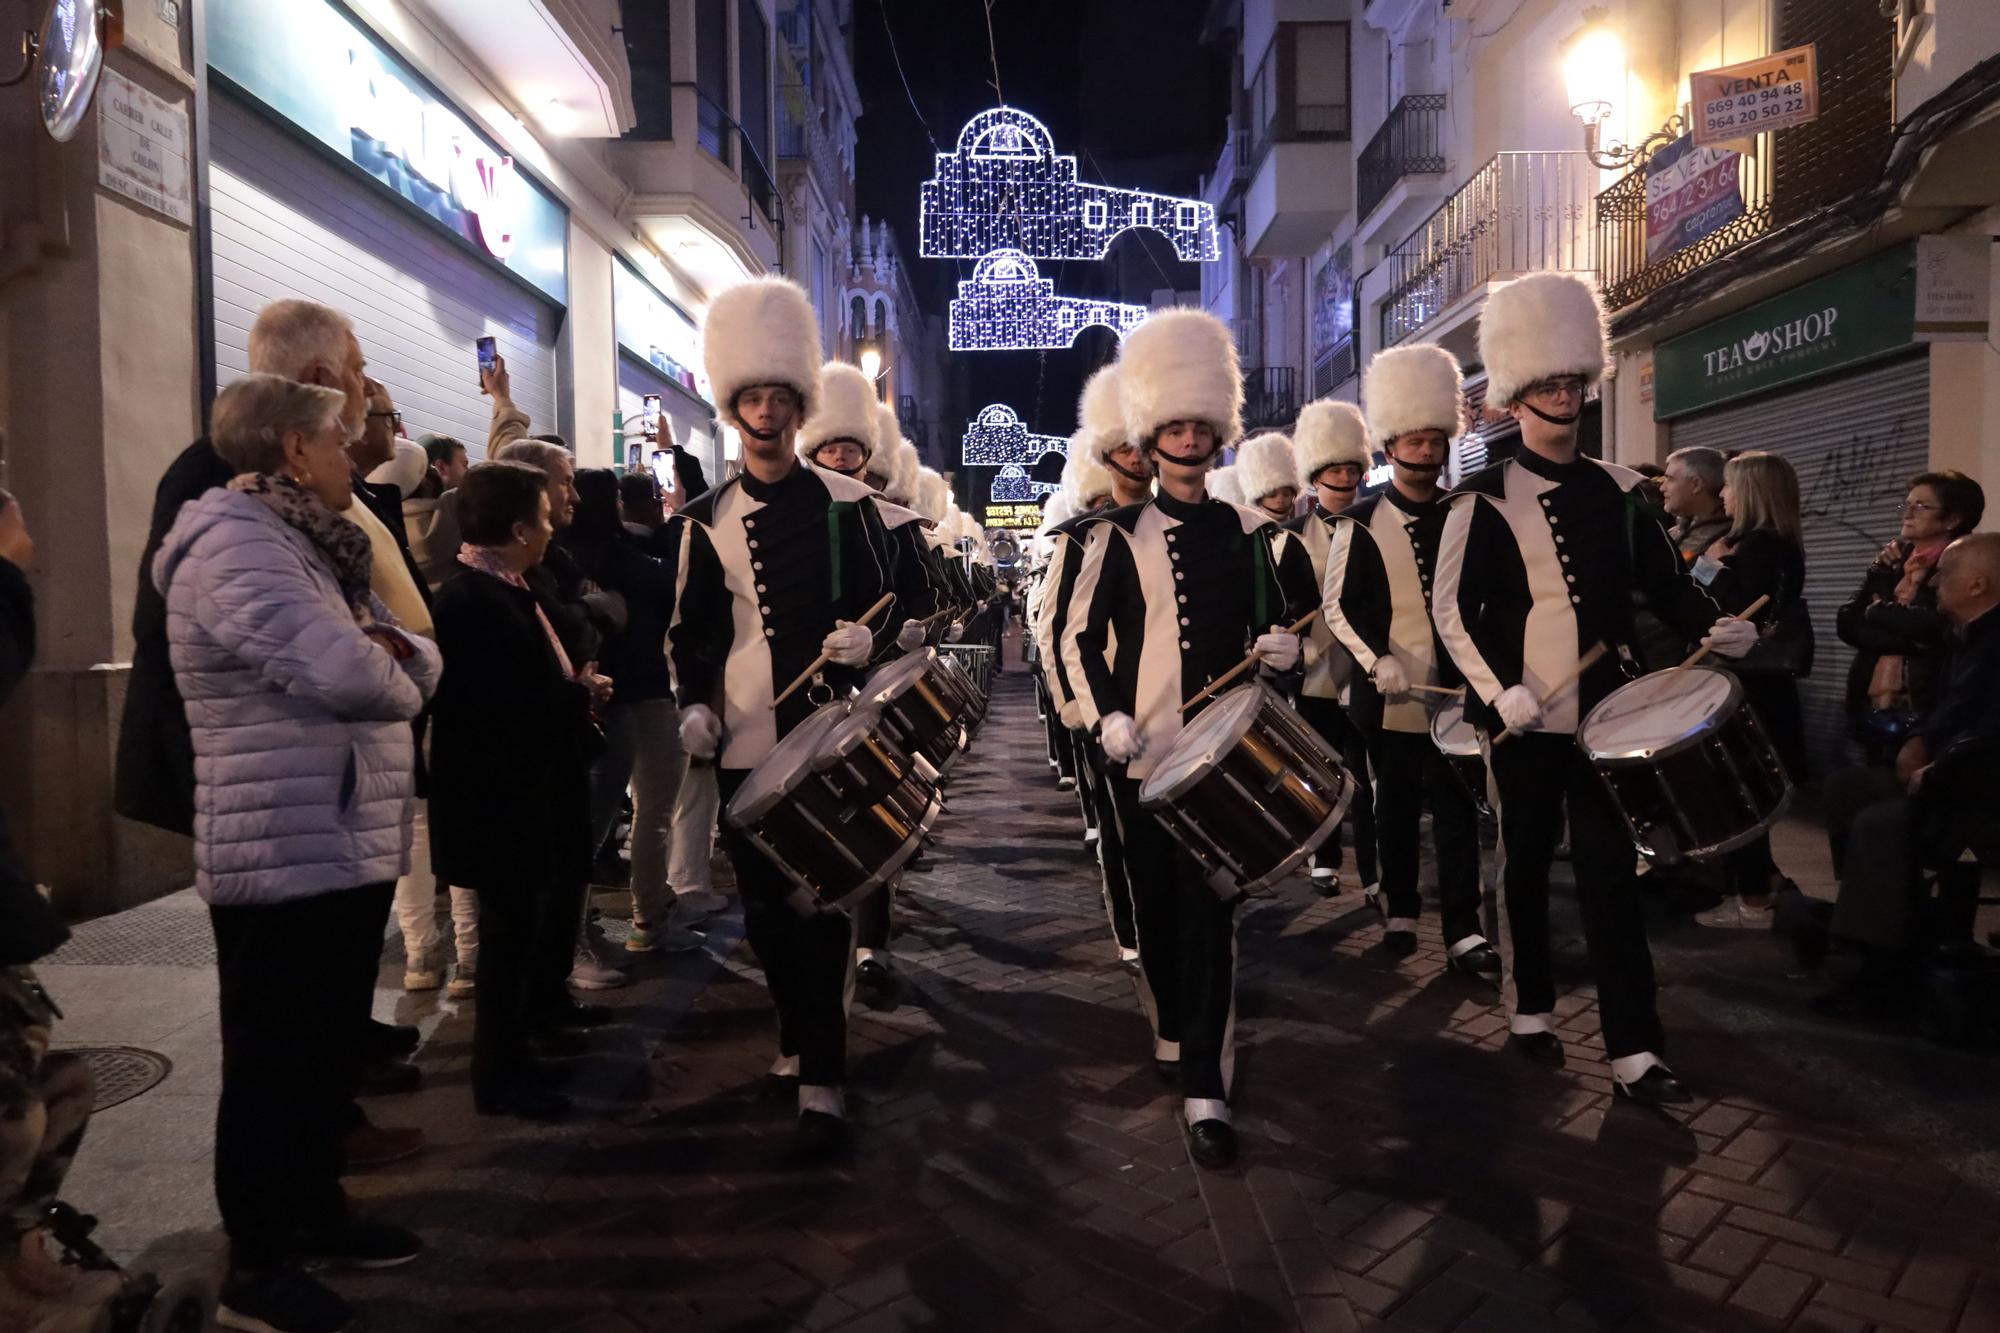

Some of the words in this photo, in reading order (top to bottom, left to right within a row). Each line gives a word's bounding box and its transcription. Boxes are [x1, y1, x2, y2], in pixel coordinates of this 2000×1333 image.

[1706, 99, 1733, 115] 669
[1738, 94, 1756, 108] 40
[1760, 88, 1779, 102] 94
[1783, 82, 1802, 95] 48
[1720, 68, 1790, 97] VENTA
[113, 98, 144, 125] CARRER
[151, 120, 173, 141] CALLE
[1707, 115, 1735, 130] 964
[1740, 110, 1757, 124] 20
[1762, 104, 1780, 118] 50
[1785, 99, 1804, 112] 22
[140, 137, 151, 151] DE
[1652, 170, 1672, 198] SE
[1677, 147, 1731, 179] VEND
[1653, 195, 1677, 224] 964
[1719, 159, 1736, 186] 66
[1703, 343, 1742, 377] TEA
[1772, 307, 1838, 354] SHOP
